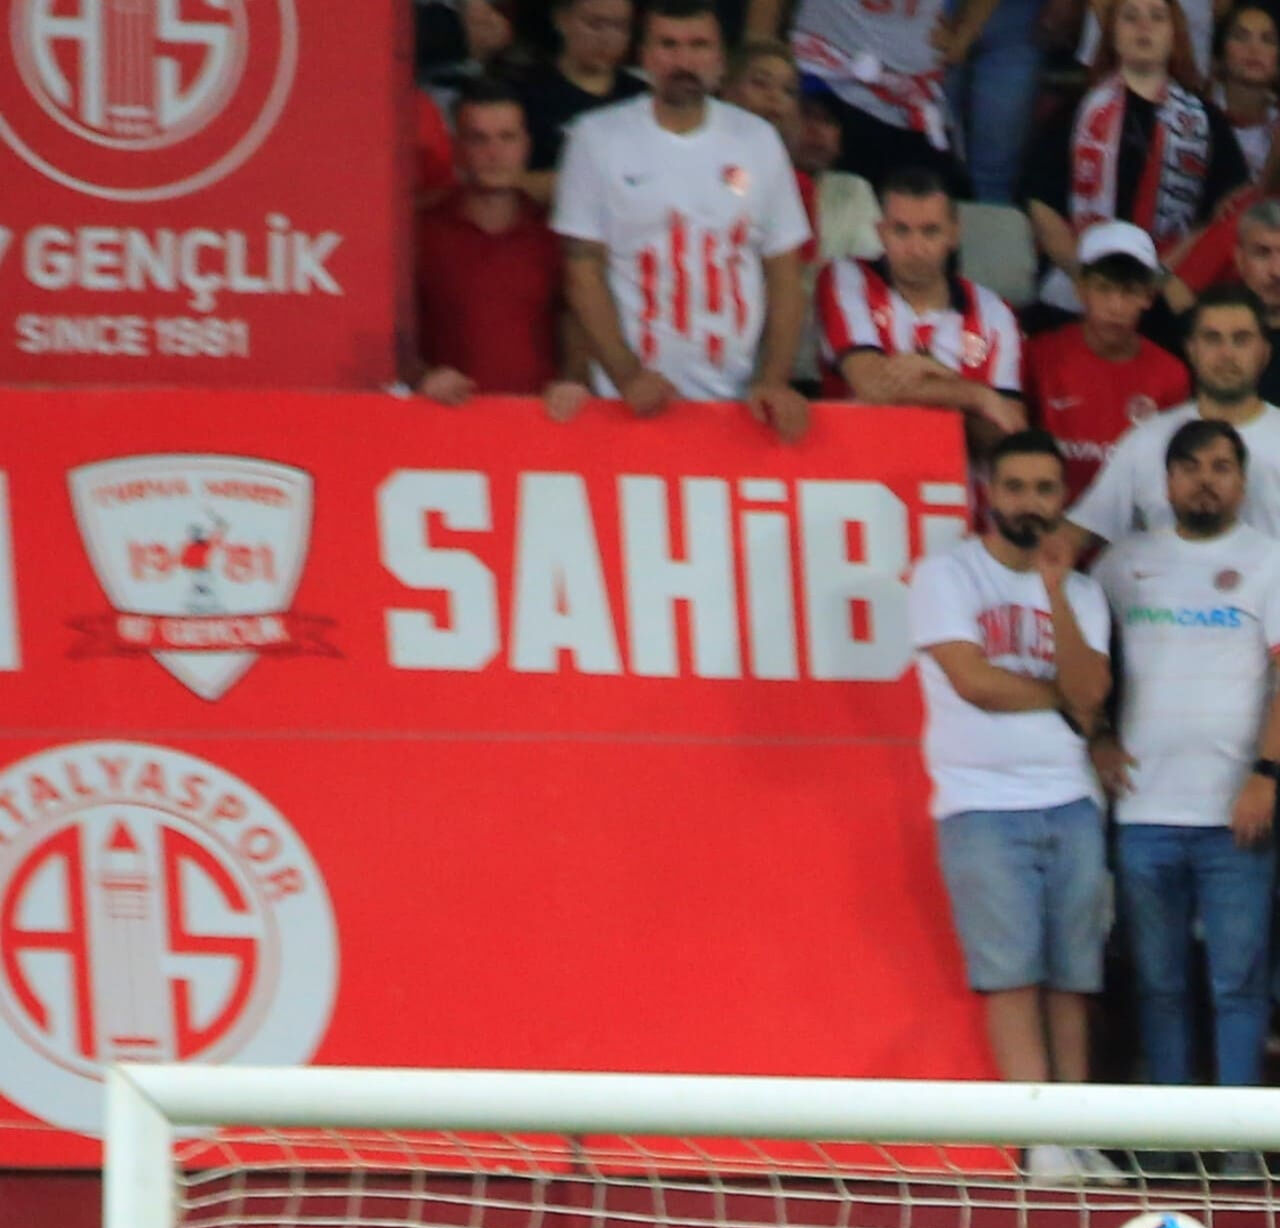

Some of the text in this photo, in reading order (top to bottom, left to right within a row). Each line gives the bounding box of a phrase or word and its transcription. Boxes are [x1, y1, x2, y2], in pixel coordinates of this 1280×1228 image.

[22, 211, 346, 313] GENÇLİK
[15, 313, 149, 356] SINCE
[0, 753, 308, 900] TALYASPOR
